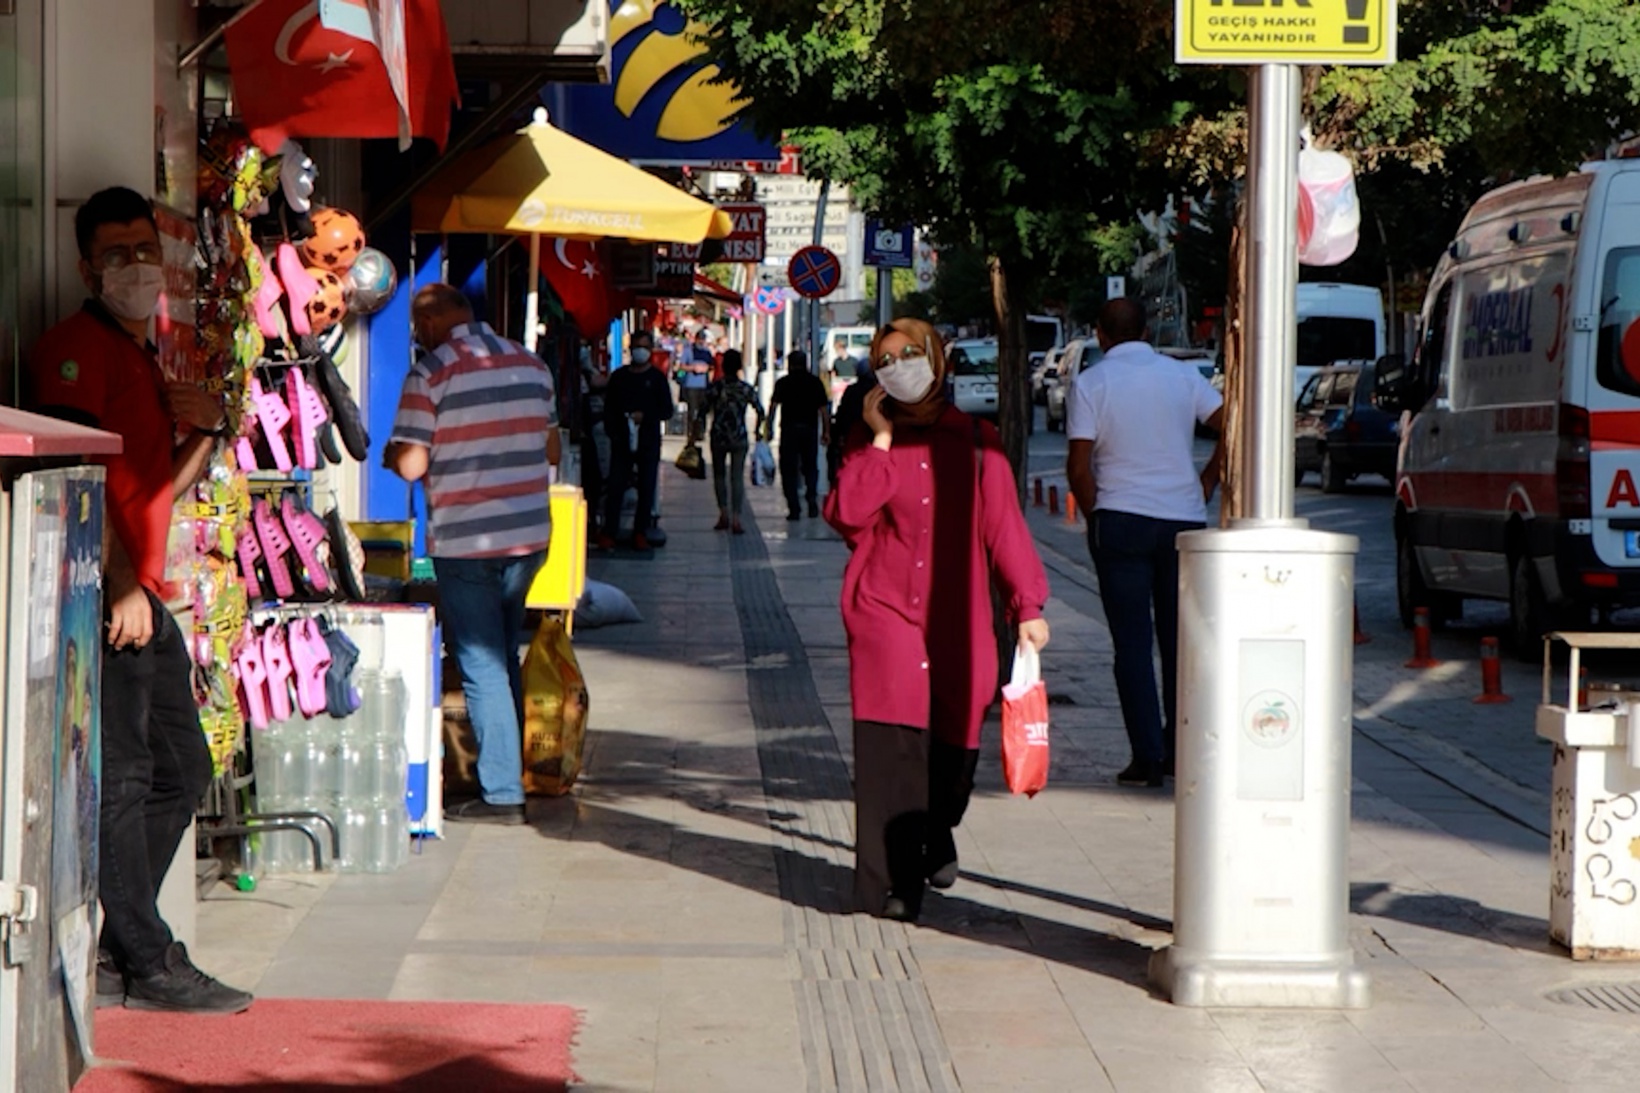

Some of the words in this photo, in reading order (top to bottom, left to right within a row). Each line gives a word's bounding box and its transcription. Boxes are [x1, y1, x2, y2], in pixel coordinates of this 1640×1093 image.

[1208, 16, 1257, 28] GEÇİŞ
[1263, 17, 1316, 27] HAKKI
[1208, 33, 1316, 43] YAYANINDIR
